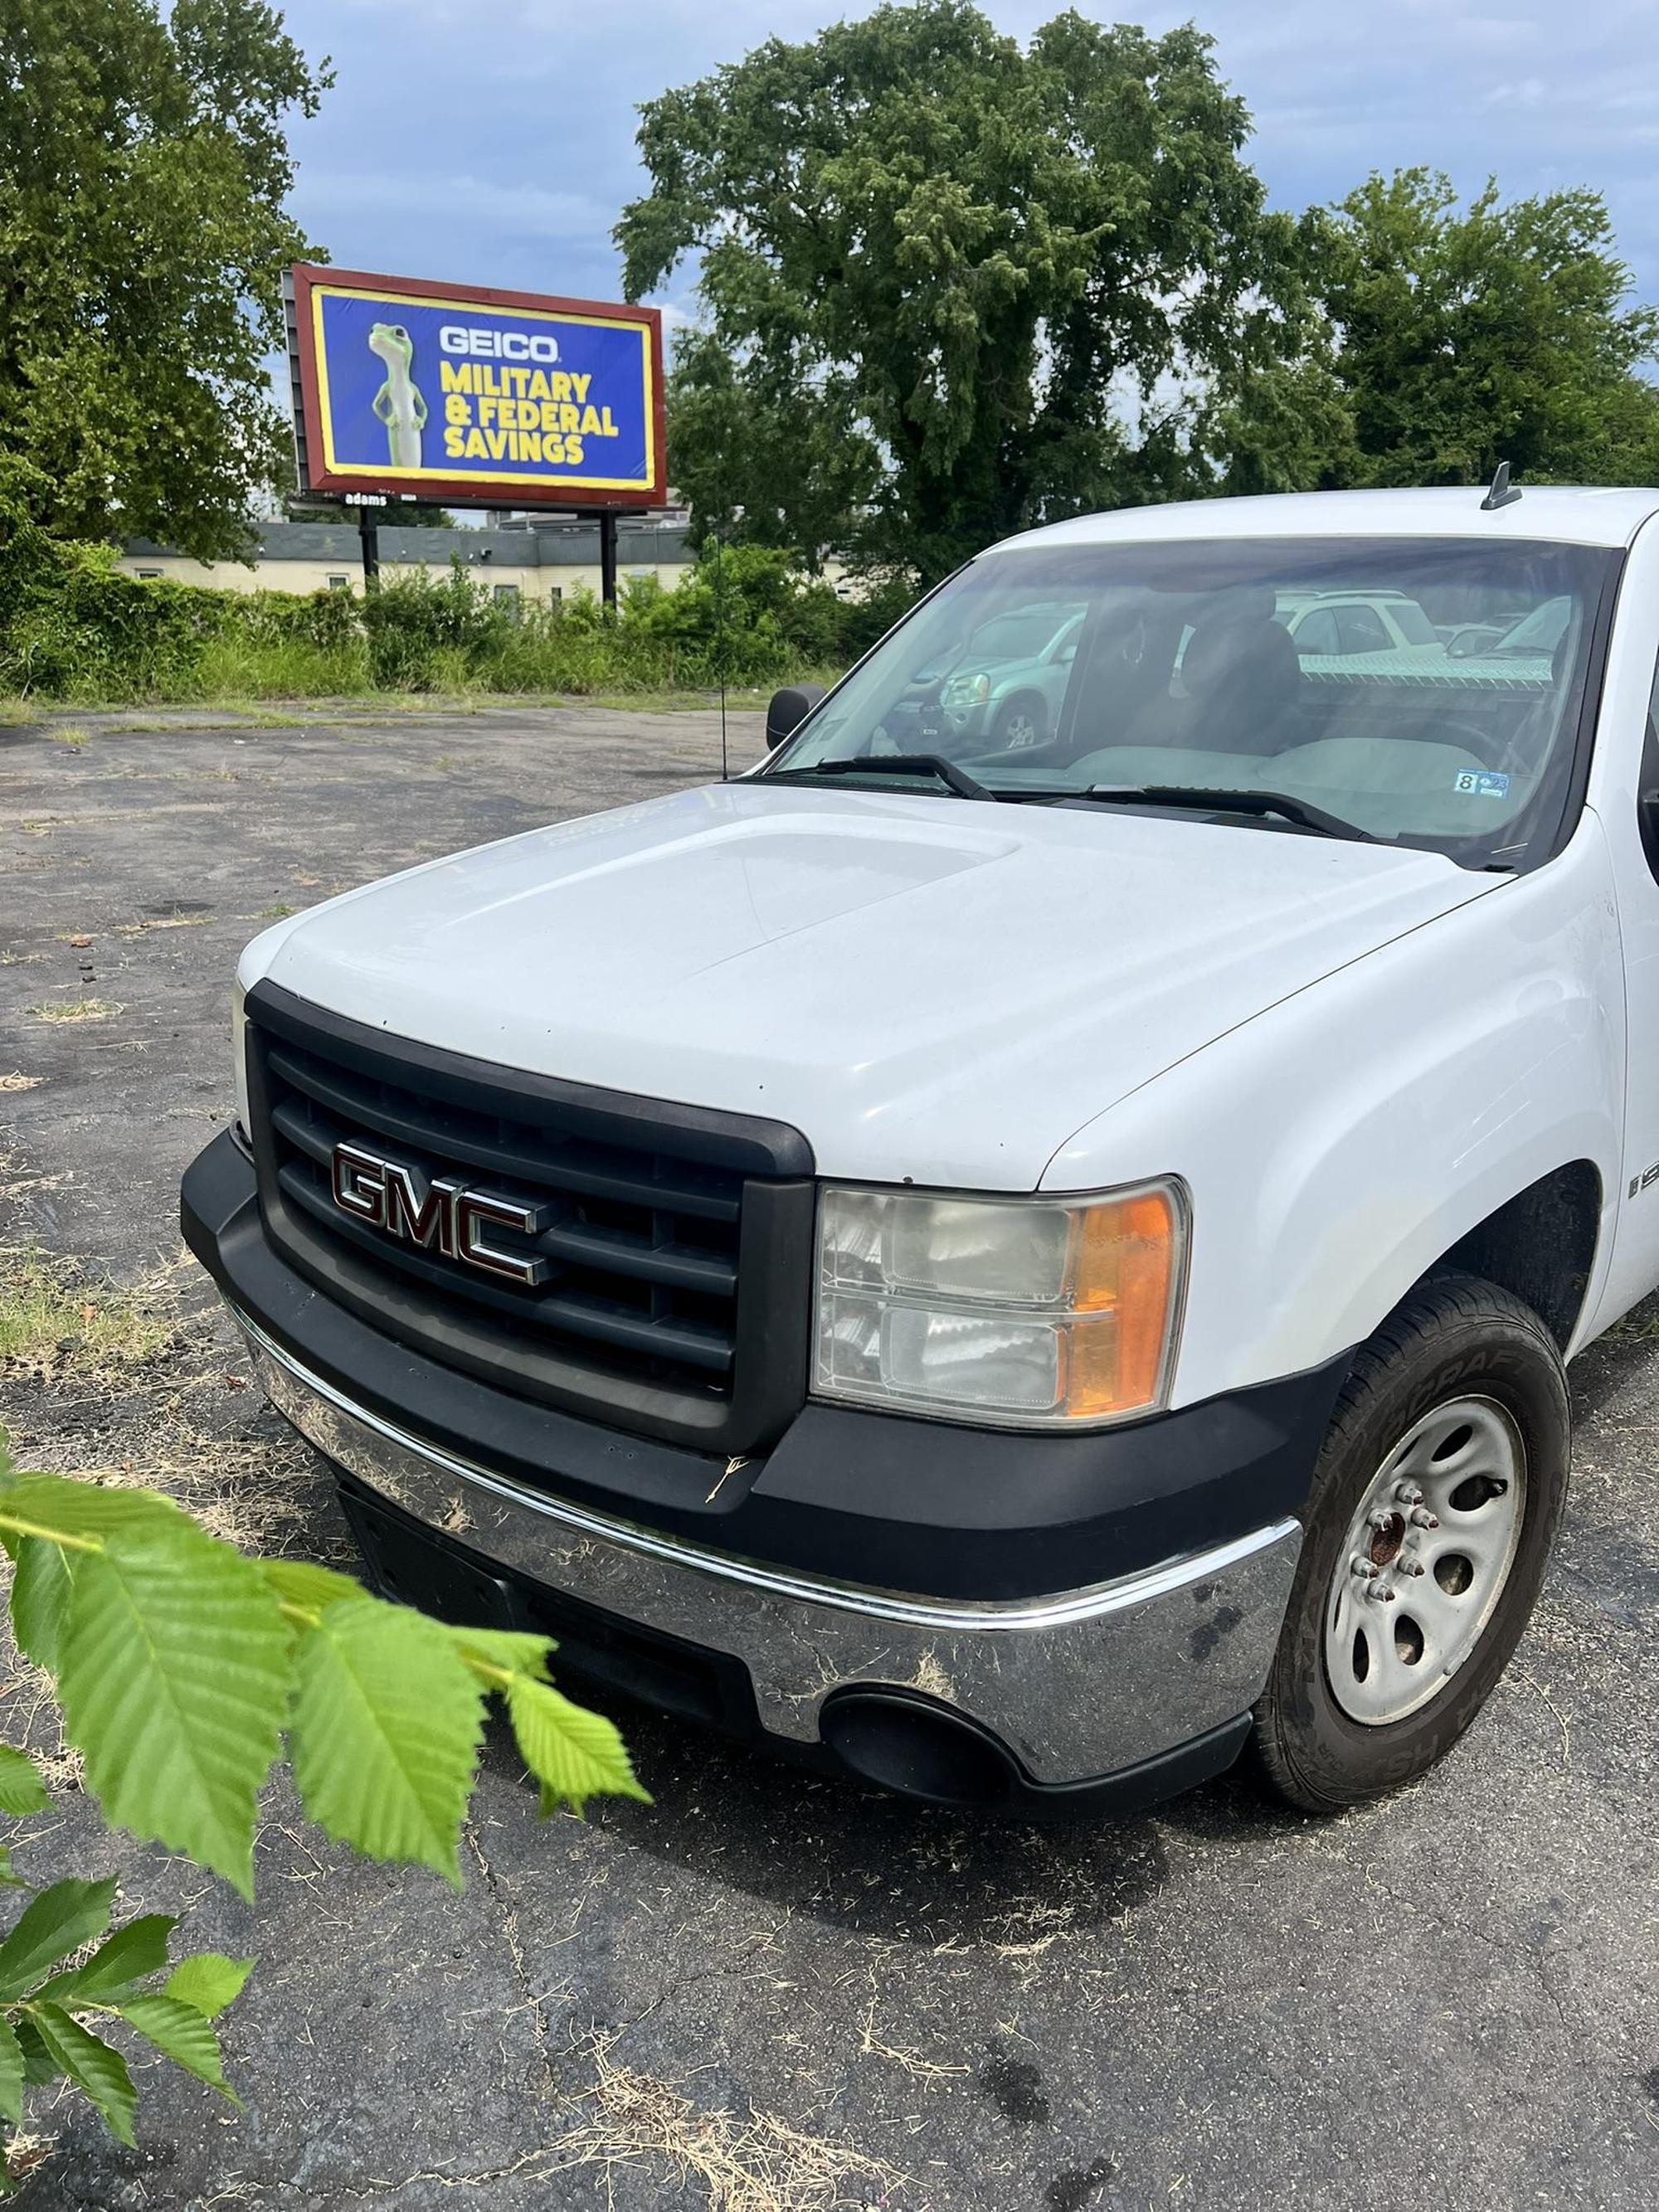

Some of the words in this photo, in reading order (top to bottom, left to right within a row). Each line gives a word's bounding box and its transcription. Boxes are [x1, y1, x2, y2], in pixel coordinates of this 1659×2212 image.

[440, 325, 558, 363] GEICO
[440, 360, 591, 403] MILITARY
[445, 394, 472, 426] &
[478, 396, 619, 437] FEDERAL
[443, 425, 585, 465] SAVINGS
[345, 492, 387, 507] adams
[1459, 775, 1472, 790] 8
[333, 1142, 542, 1286] GMC
